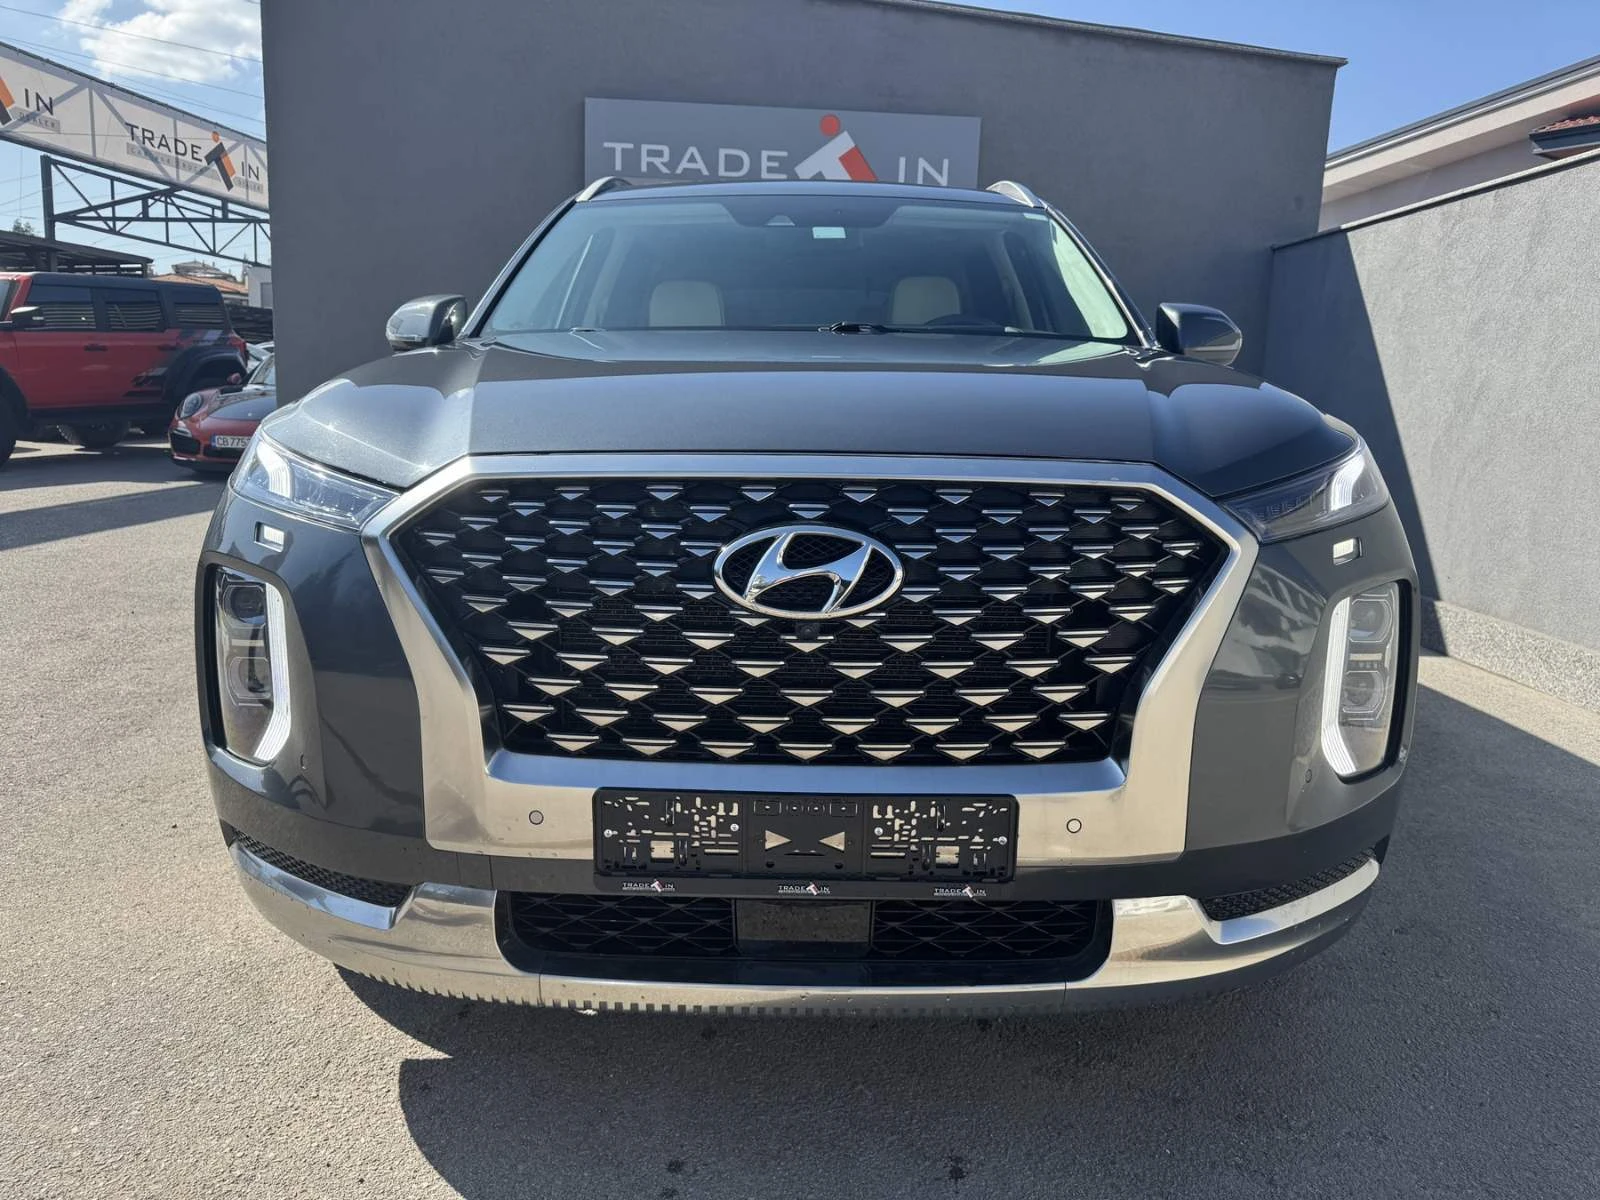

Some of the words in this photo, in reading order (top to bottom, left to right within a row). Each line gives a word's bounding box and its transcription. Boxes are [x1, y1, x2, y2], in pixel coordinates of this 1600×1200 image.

[24, 88, 53, 116] IN
[125, 122, 203, 163] TRADE
[240, 161, 260, 181] IN
[603, 142, 789, 180] TRADE
[898, 156, 950, 186] IN
